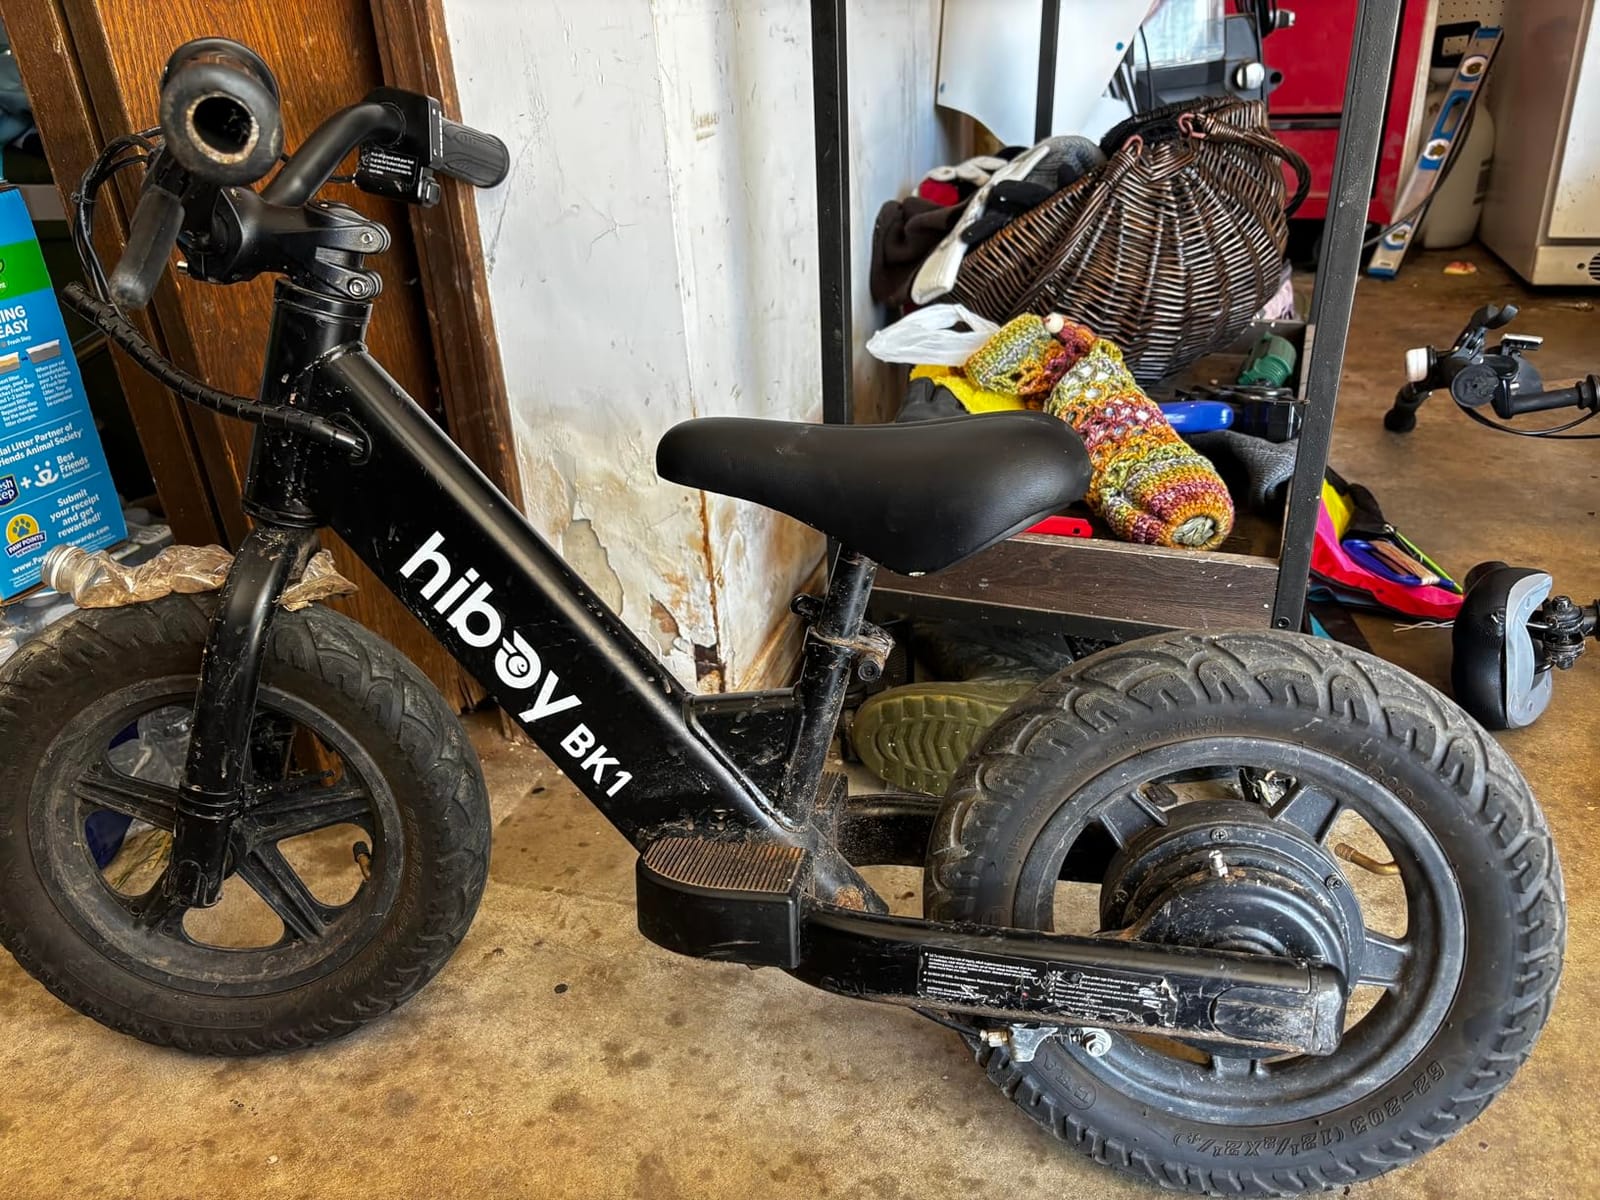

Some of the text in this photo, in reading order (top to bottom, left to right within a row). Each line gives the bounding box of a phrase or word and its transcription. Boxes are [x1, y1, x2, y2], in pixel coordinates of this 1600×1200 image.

[0, 305, 26, 323] ING
[0, 422, 73, 457] ial Litter Partner of
[0, 452, 25, 468] riends
[26, 440, 55, 457] Animal
[57, 452, 75, 465] Best
[59, 456, 89, 473] Friends
[49, 494, 100, 523] your receipt
[57, 488, 88, 507] Submit
[62, 506, 95, 526] and get
[400, 530, 633, 798] hiboy BK1
[1349, 1060, 1446, 1136] 62-203
